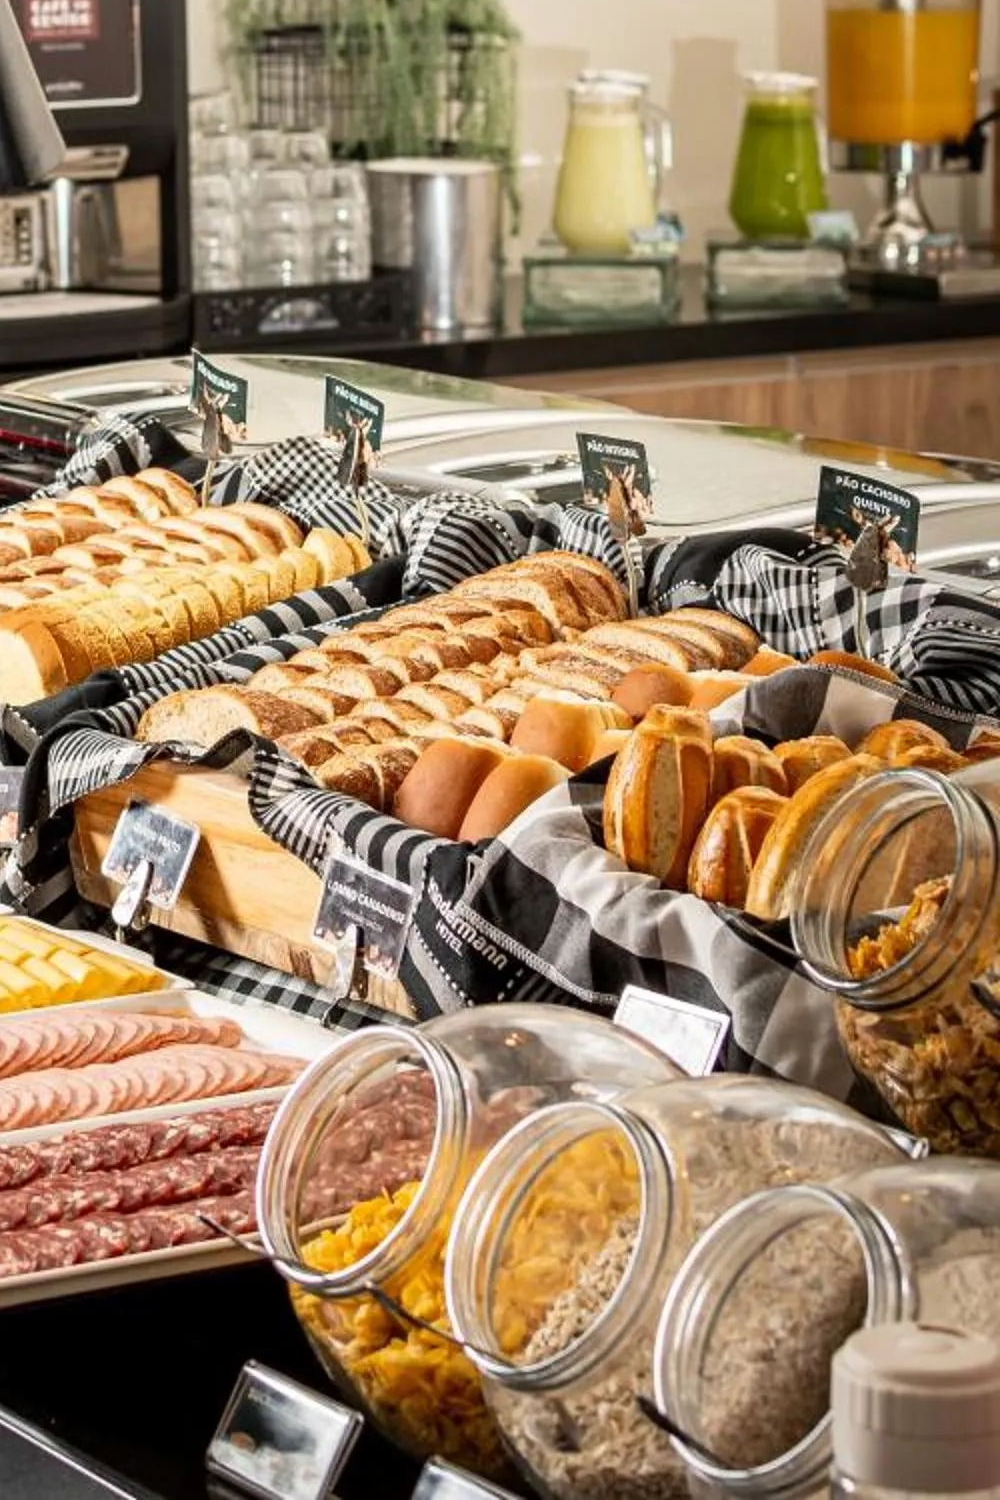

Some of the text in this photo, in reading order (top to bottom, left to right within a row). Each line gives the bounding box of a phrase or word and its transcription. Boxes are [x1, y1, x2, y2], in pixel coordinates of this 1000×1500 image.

[835, 475, 911, 509] PÃO CACHORRO
[435, 919, 463, 957] HOTEL
